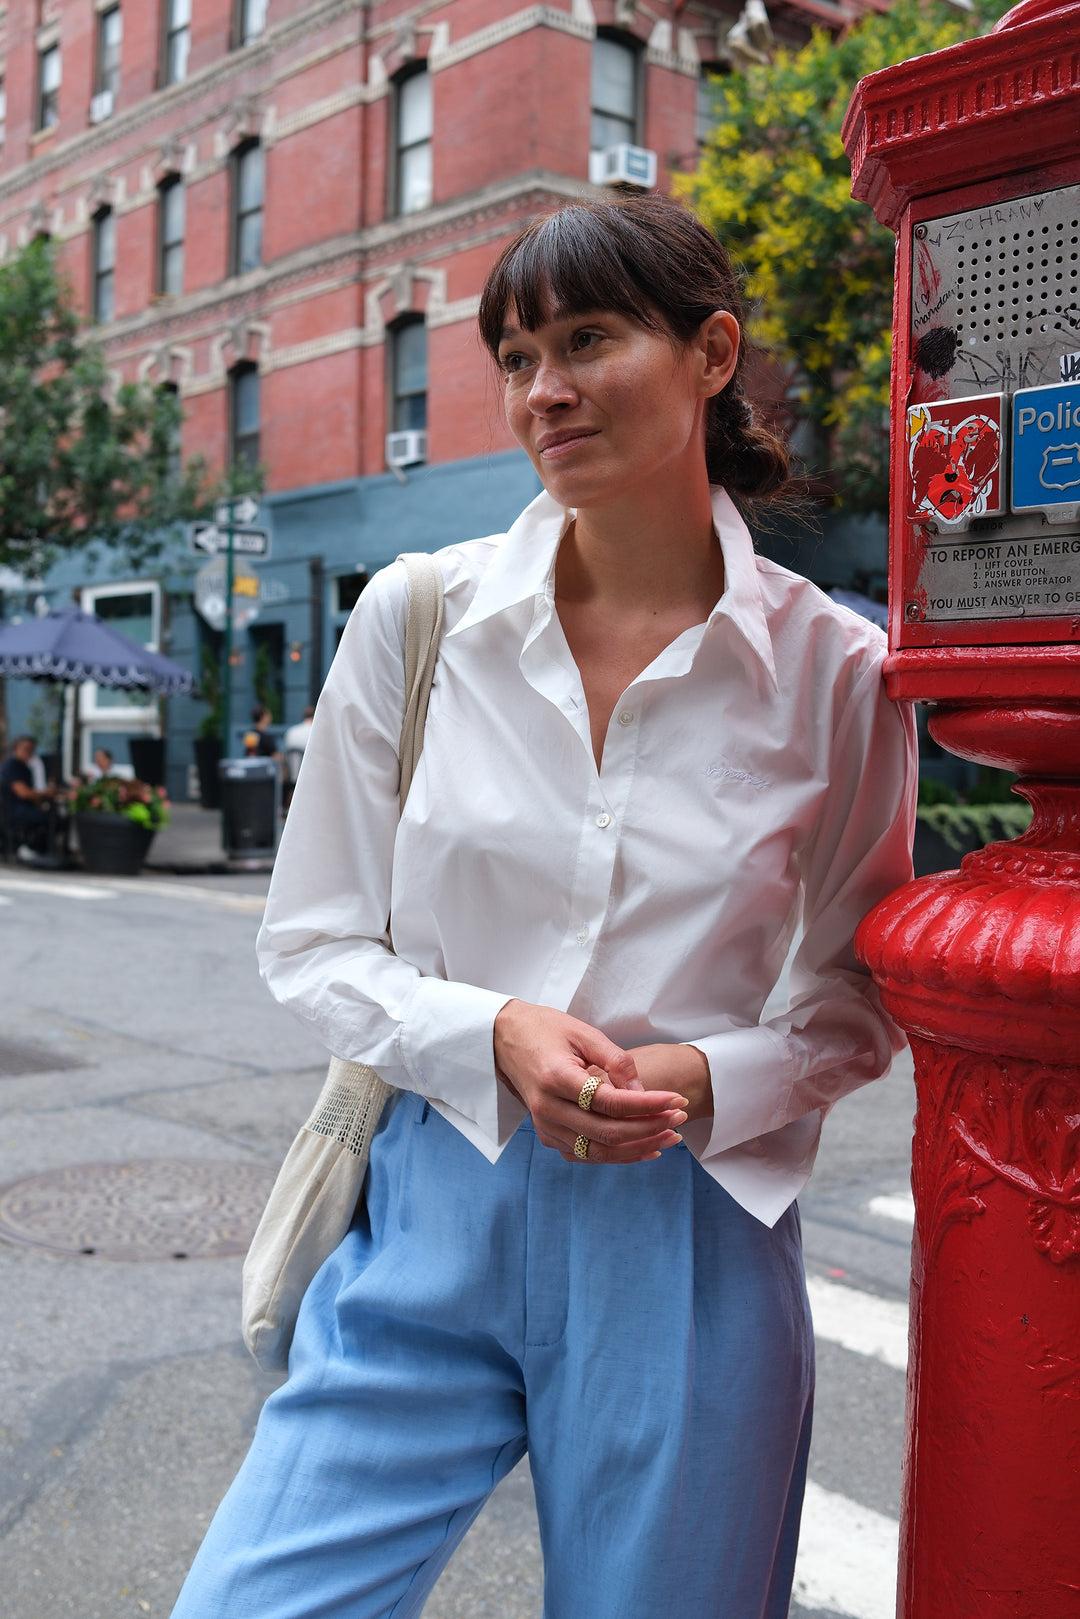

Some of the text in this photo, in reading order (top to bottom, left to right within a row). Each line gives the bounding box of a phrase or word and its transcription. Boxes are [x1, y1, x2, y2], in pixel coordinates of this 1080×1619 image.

[931, 540, 1080, 563] TO REPORT AN EMERG
[973, 559, 1034, 570] 1. LIFT COVER
[973, 568, 1046, 580] 2. PUSH BUTTON
[985, 580, 1021, 588] ANSWER
[1025, 576, 1072, 586] OPERATOR
[930, 599, 953, 609] YOU
[957, 597, 986, 608] MUST
[991, 594, 1040, 606] ANSWER
[1045, 593, 1060, 603] TO
